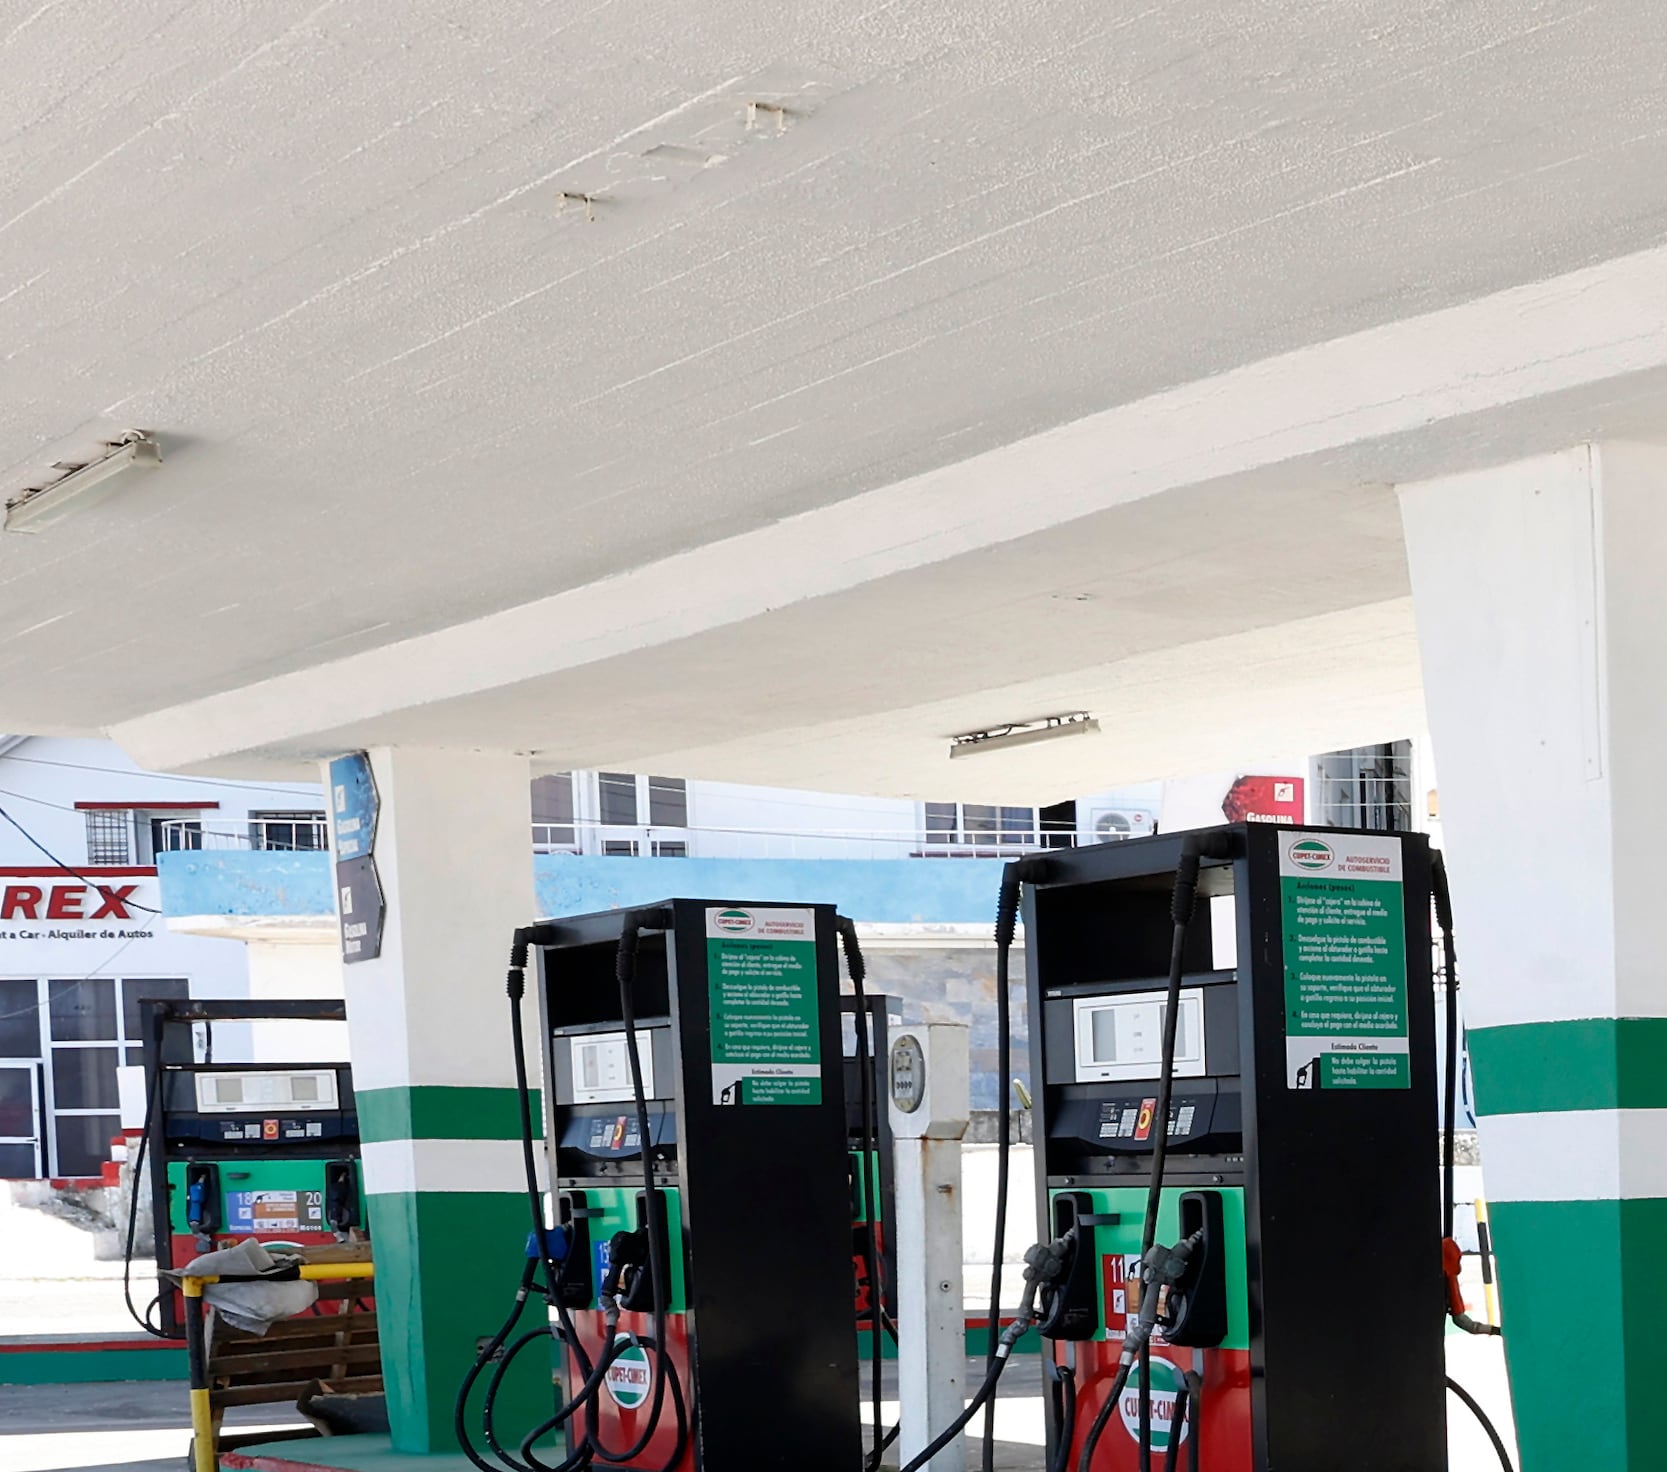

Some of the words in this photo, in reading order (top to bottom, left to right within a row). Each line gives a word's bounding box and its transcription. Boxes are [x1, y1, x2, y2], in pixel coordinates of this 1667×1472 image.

[0, 885, 139, 920] REX
[19, 930, 40, 939] Car
[48, 930, 97, 941] Alquiler
[100, 930, 115, 939] de
[118, 930, 153, 939] Autos
[236, 1193, 252, 1205] 18
[306, 1192, 322, 1205] 20
[1111, 1256, 1124, 1283] 11
